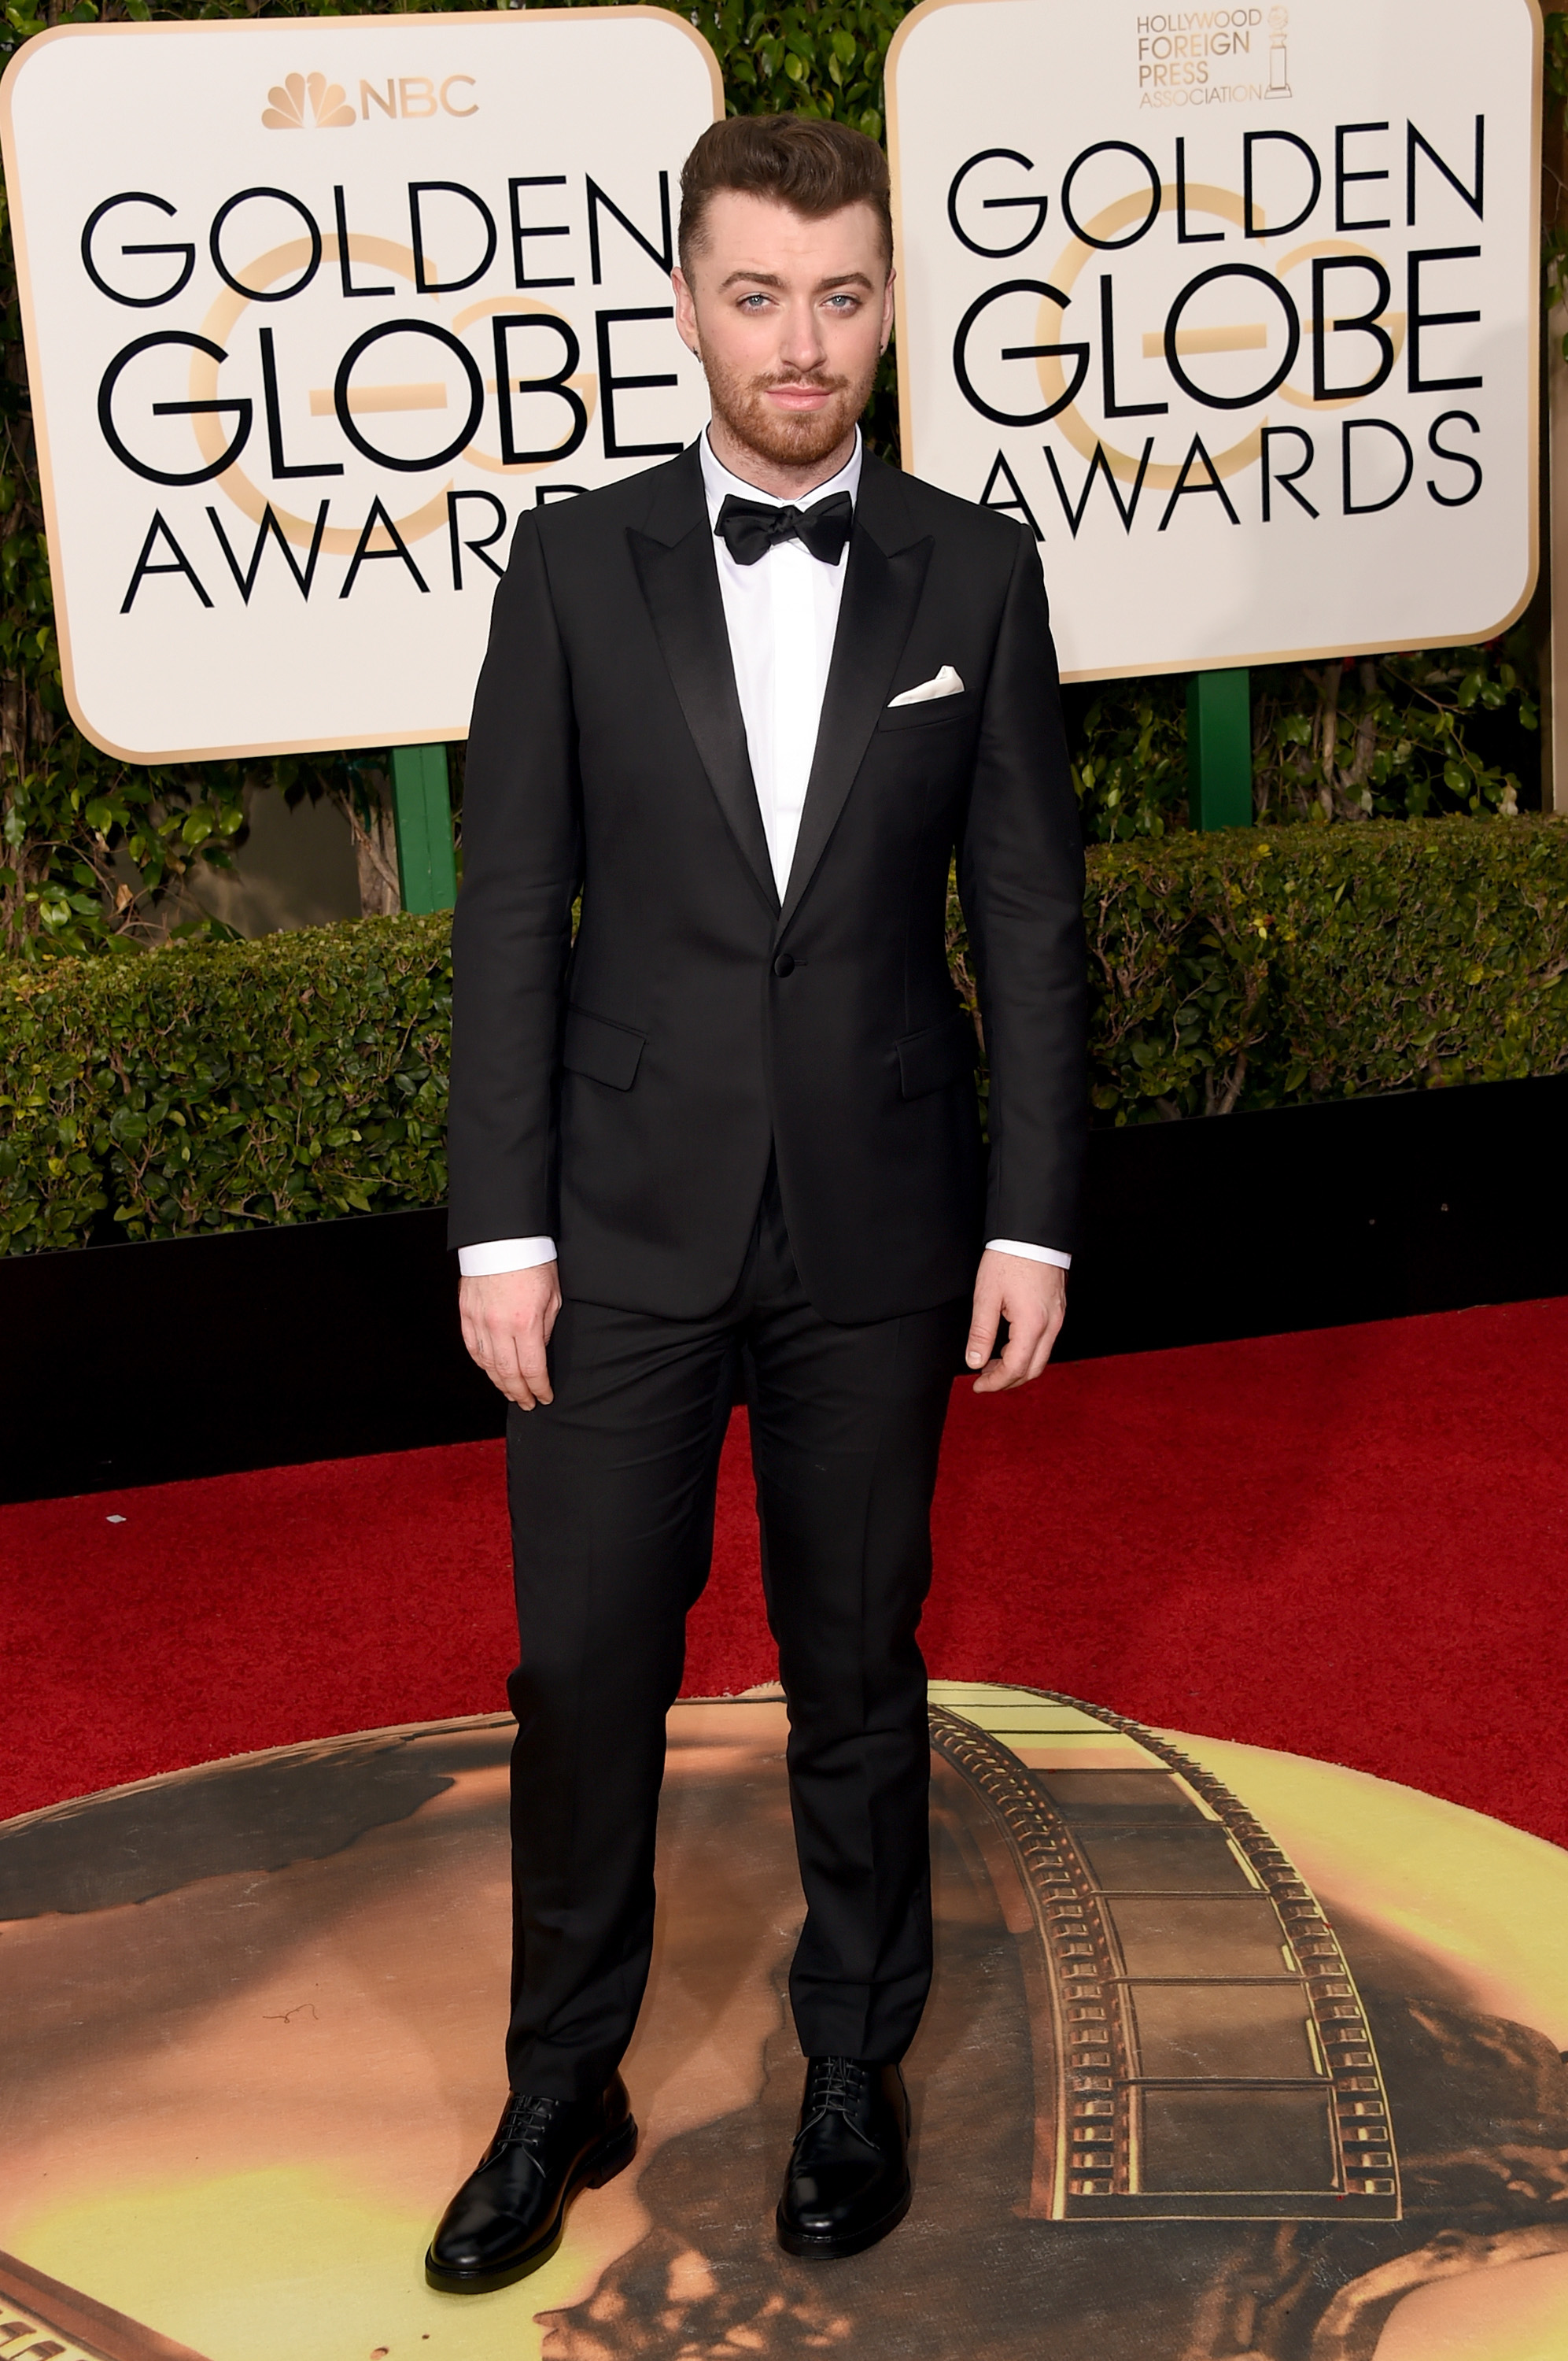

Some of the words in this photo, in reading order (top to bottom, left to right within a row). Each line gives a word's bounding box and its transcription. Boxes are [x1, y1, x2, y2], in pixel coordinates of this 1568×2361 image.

[1137, 9, 1262, 34] HOLLYWOOD
[1138, 31, 1250, 61] FOREIGN
[1139, 61, 1208, 88] PRESS
[359, 74, 479, 120] NBC
[1139, 84, 1262, 109] ASSOCIATION
[81, 170, 673, 308] GOLDEN
[947, 114, 1485, 259] GOLDEN
[98, 306, 684, 486] GLOBE
[953, 245, 1484, 427] GLOBE
[979, 410, 1483, 542] AWARDS
[120, 483, 591, 615] AWAR
